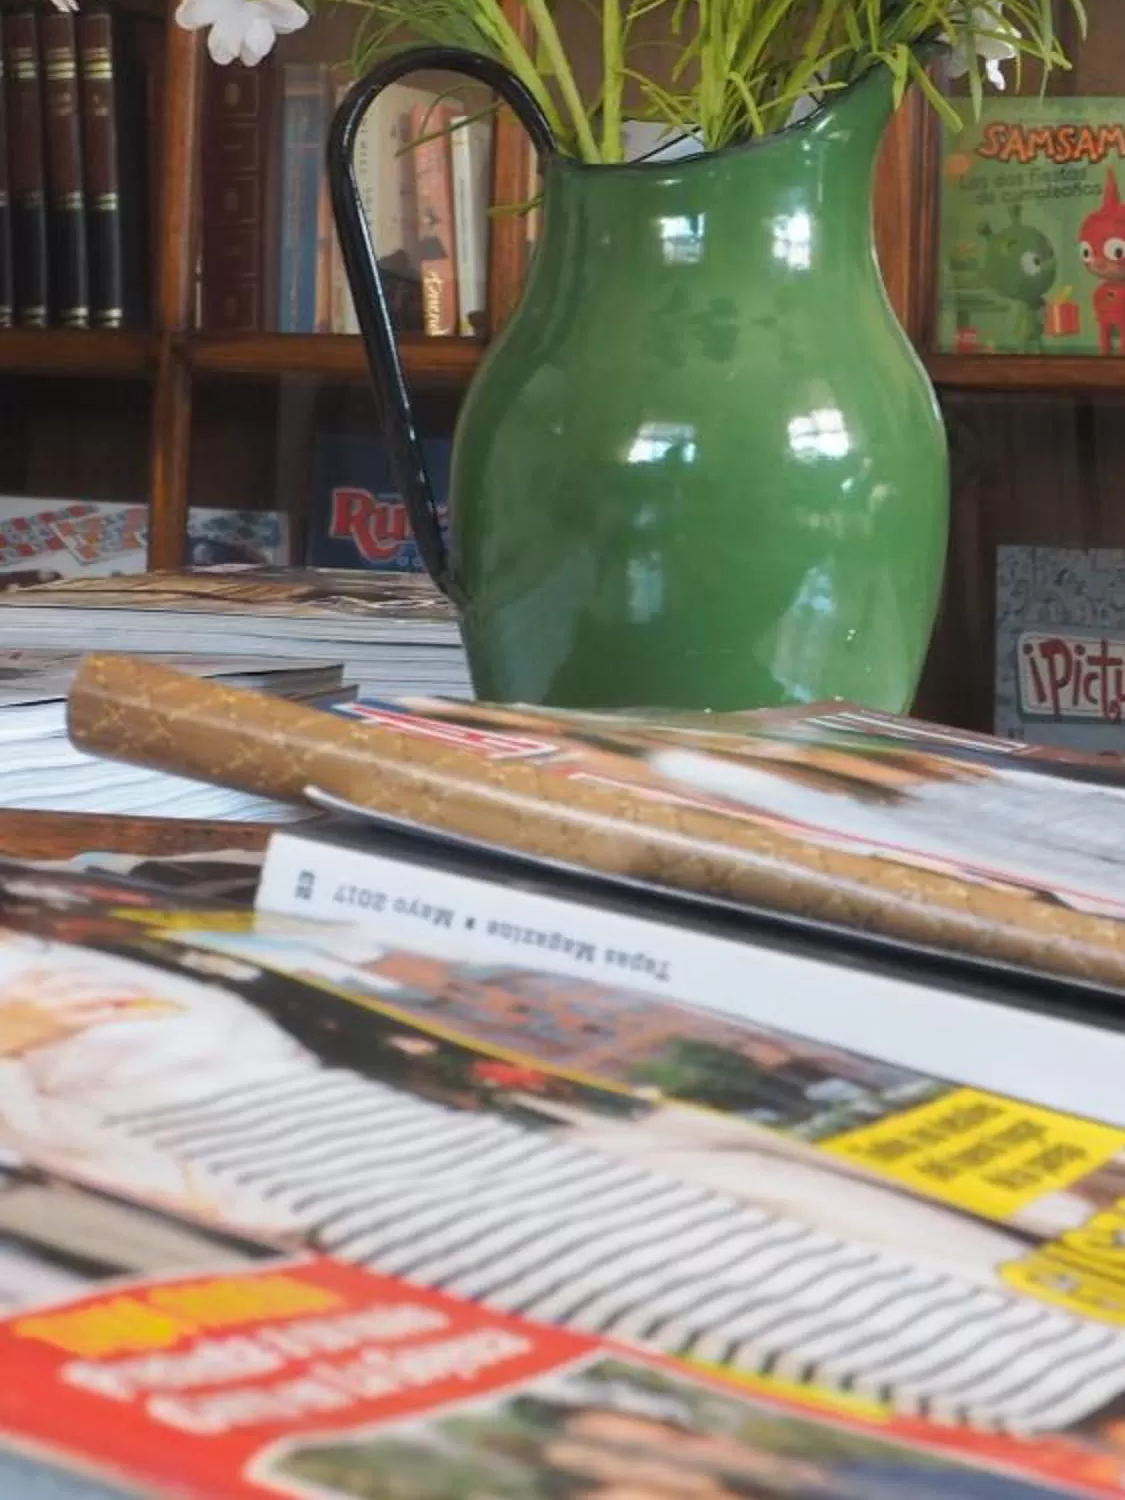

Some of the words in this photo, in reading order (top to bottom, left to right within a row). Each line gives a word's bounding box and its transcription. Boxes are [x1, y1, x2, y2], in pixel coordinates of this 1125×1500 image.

[333, 885, 389, 913] 2017
[392, 898, 455, 930] Mayo
[487, 919, 597, 962] Magazine
[604, 948, 671, 983] Tapas
